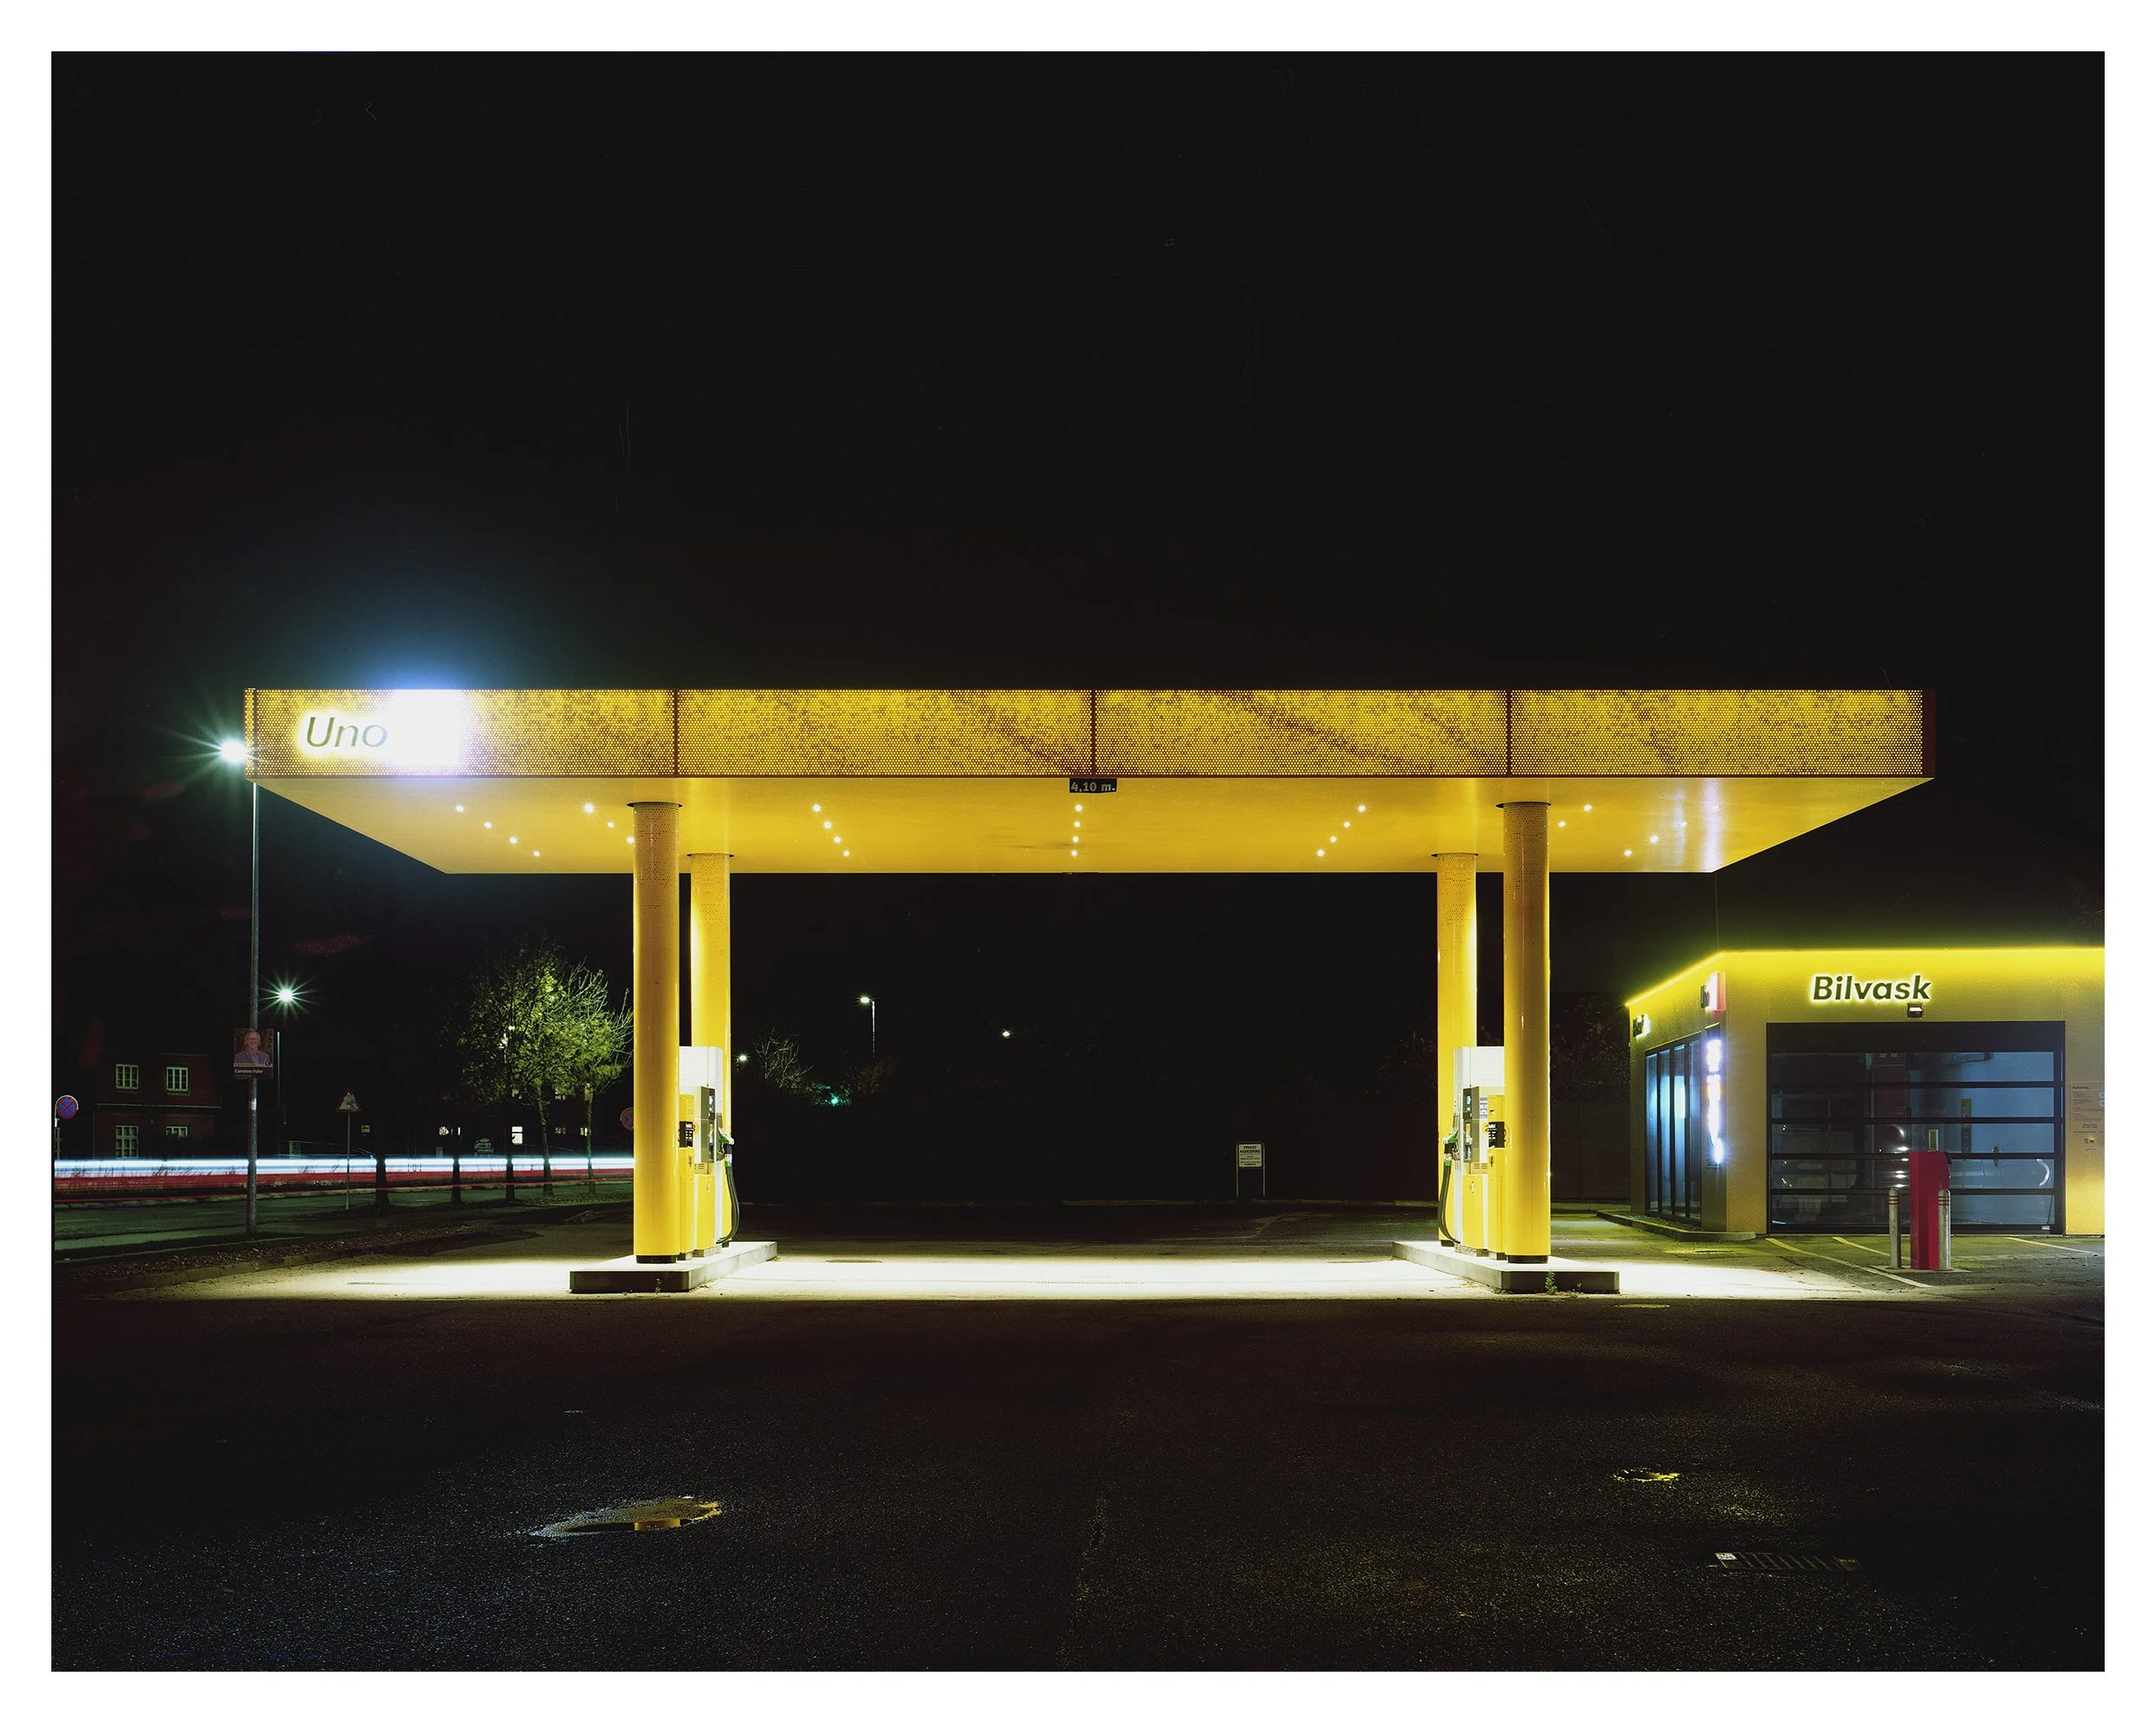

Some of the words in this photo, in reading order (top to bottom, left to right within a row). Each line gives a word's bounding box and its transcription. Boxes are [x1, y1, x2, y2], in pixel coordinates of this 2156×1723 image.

[306, 716, 388, 748] Uno
[1070, 782, 1097, 792] 4,10
[1813, 975, 1932, 1001] Bilvask
